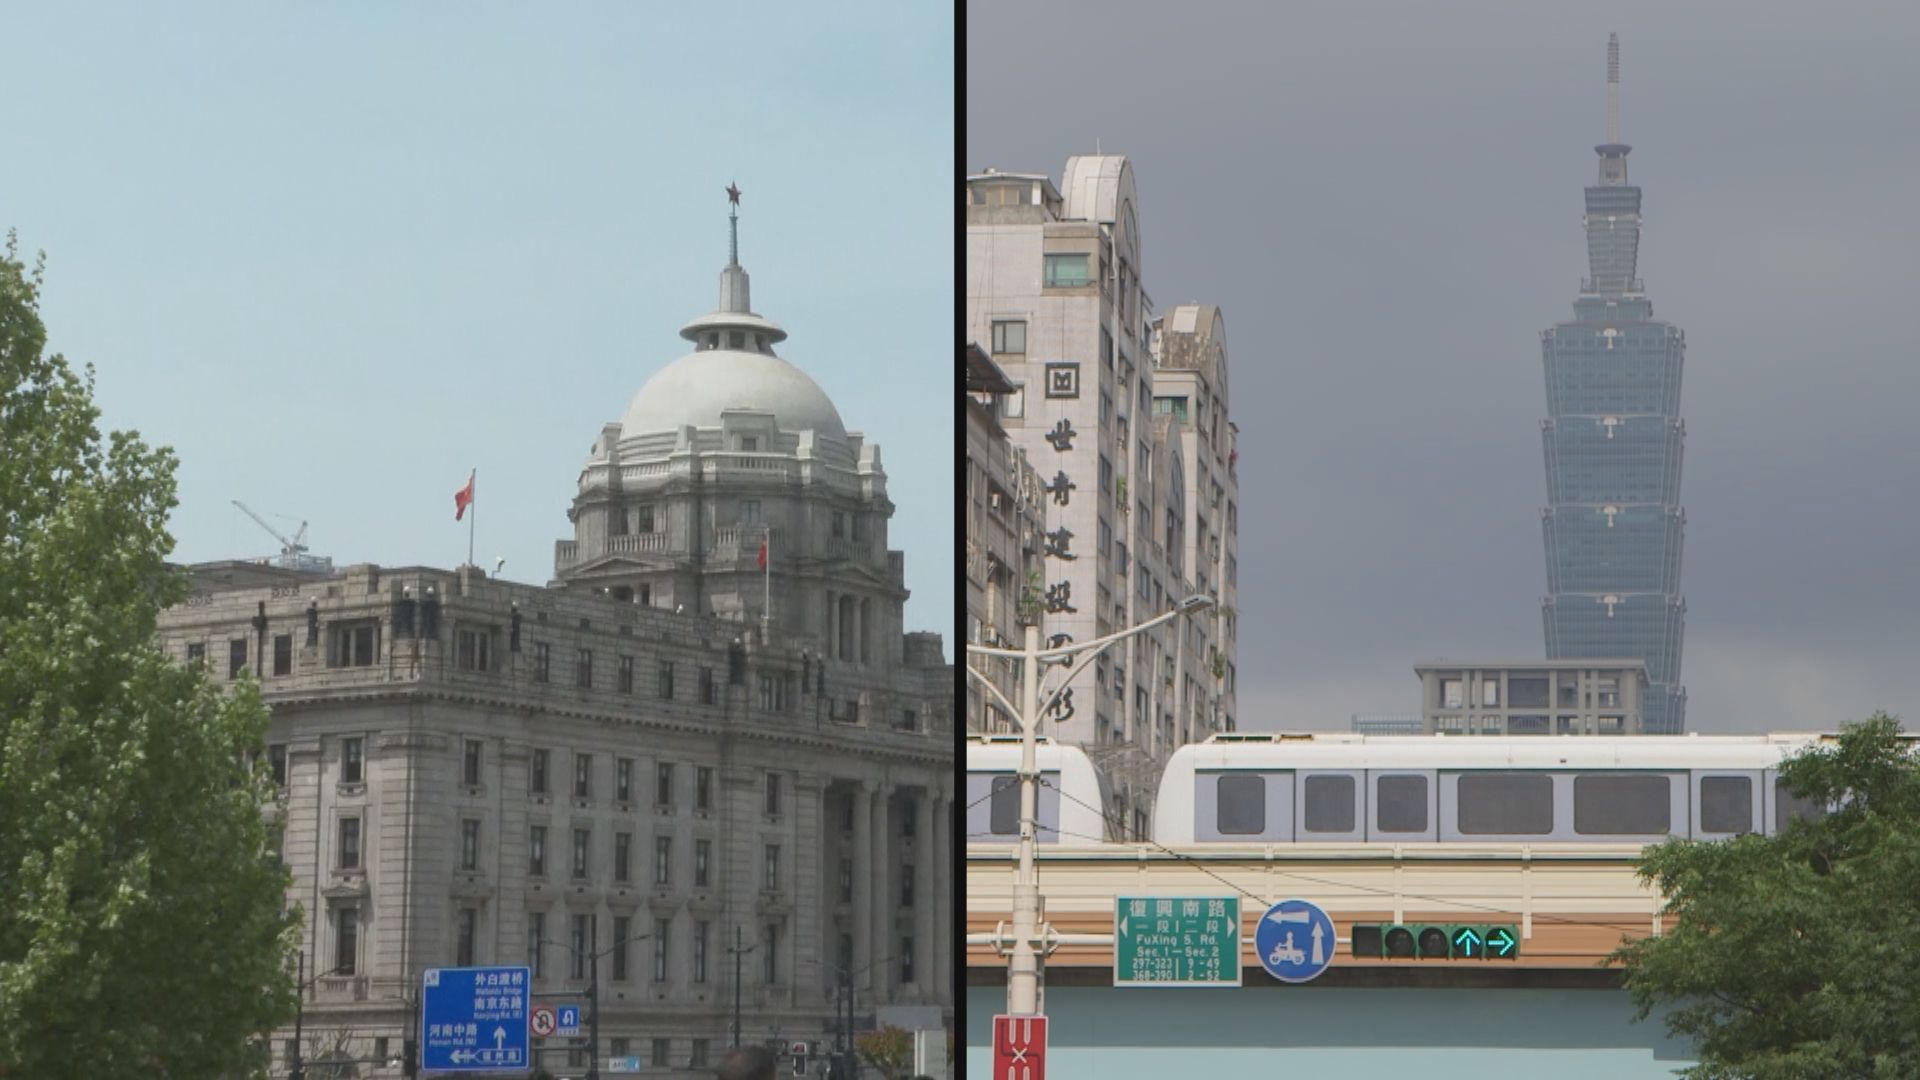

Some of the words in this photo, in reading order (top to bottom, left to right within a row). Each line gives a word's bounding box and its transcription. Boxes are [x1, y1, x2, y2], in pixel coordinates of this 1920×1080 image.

[1130, 899, 1225, 917] 復興南路
[1136, 934, 1177, 946] FuXing
[1184, 934, 1194, 945] S.
[1200, 934, 1219, 945] Rd.
[1137, 946, 1160, 957] Sec.
[1185, 946, 1209, 957] Sec.
[1212, 946, 1220, 957] 2
[1132, 958, 1172, 969] 297-323
[475, 972, 523, 986] 外白渡桥
[474, 996, 522, 1010] 南京东路
[474, 1011, 500, 1021] Nanjing
[429, 1023, 477, 1037] 河南中路
